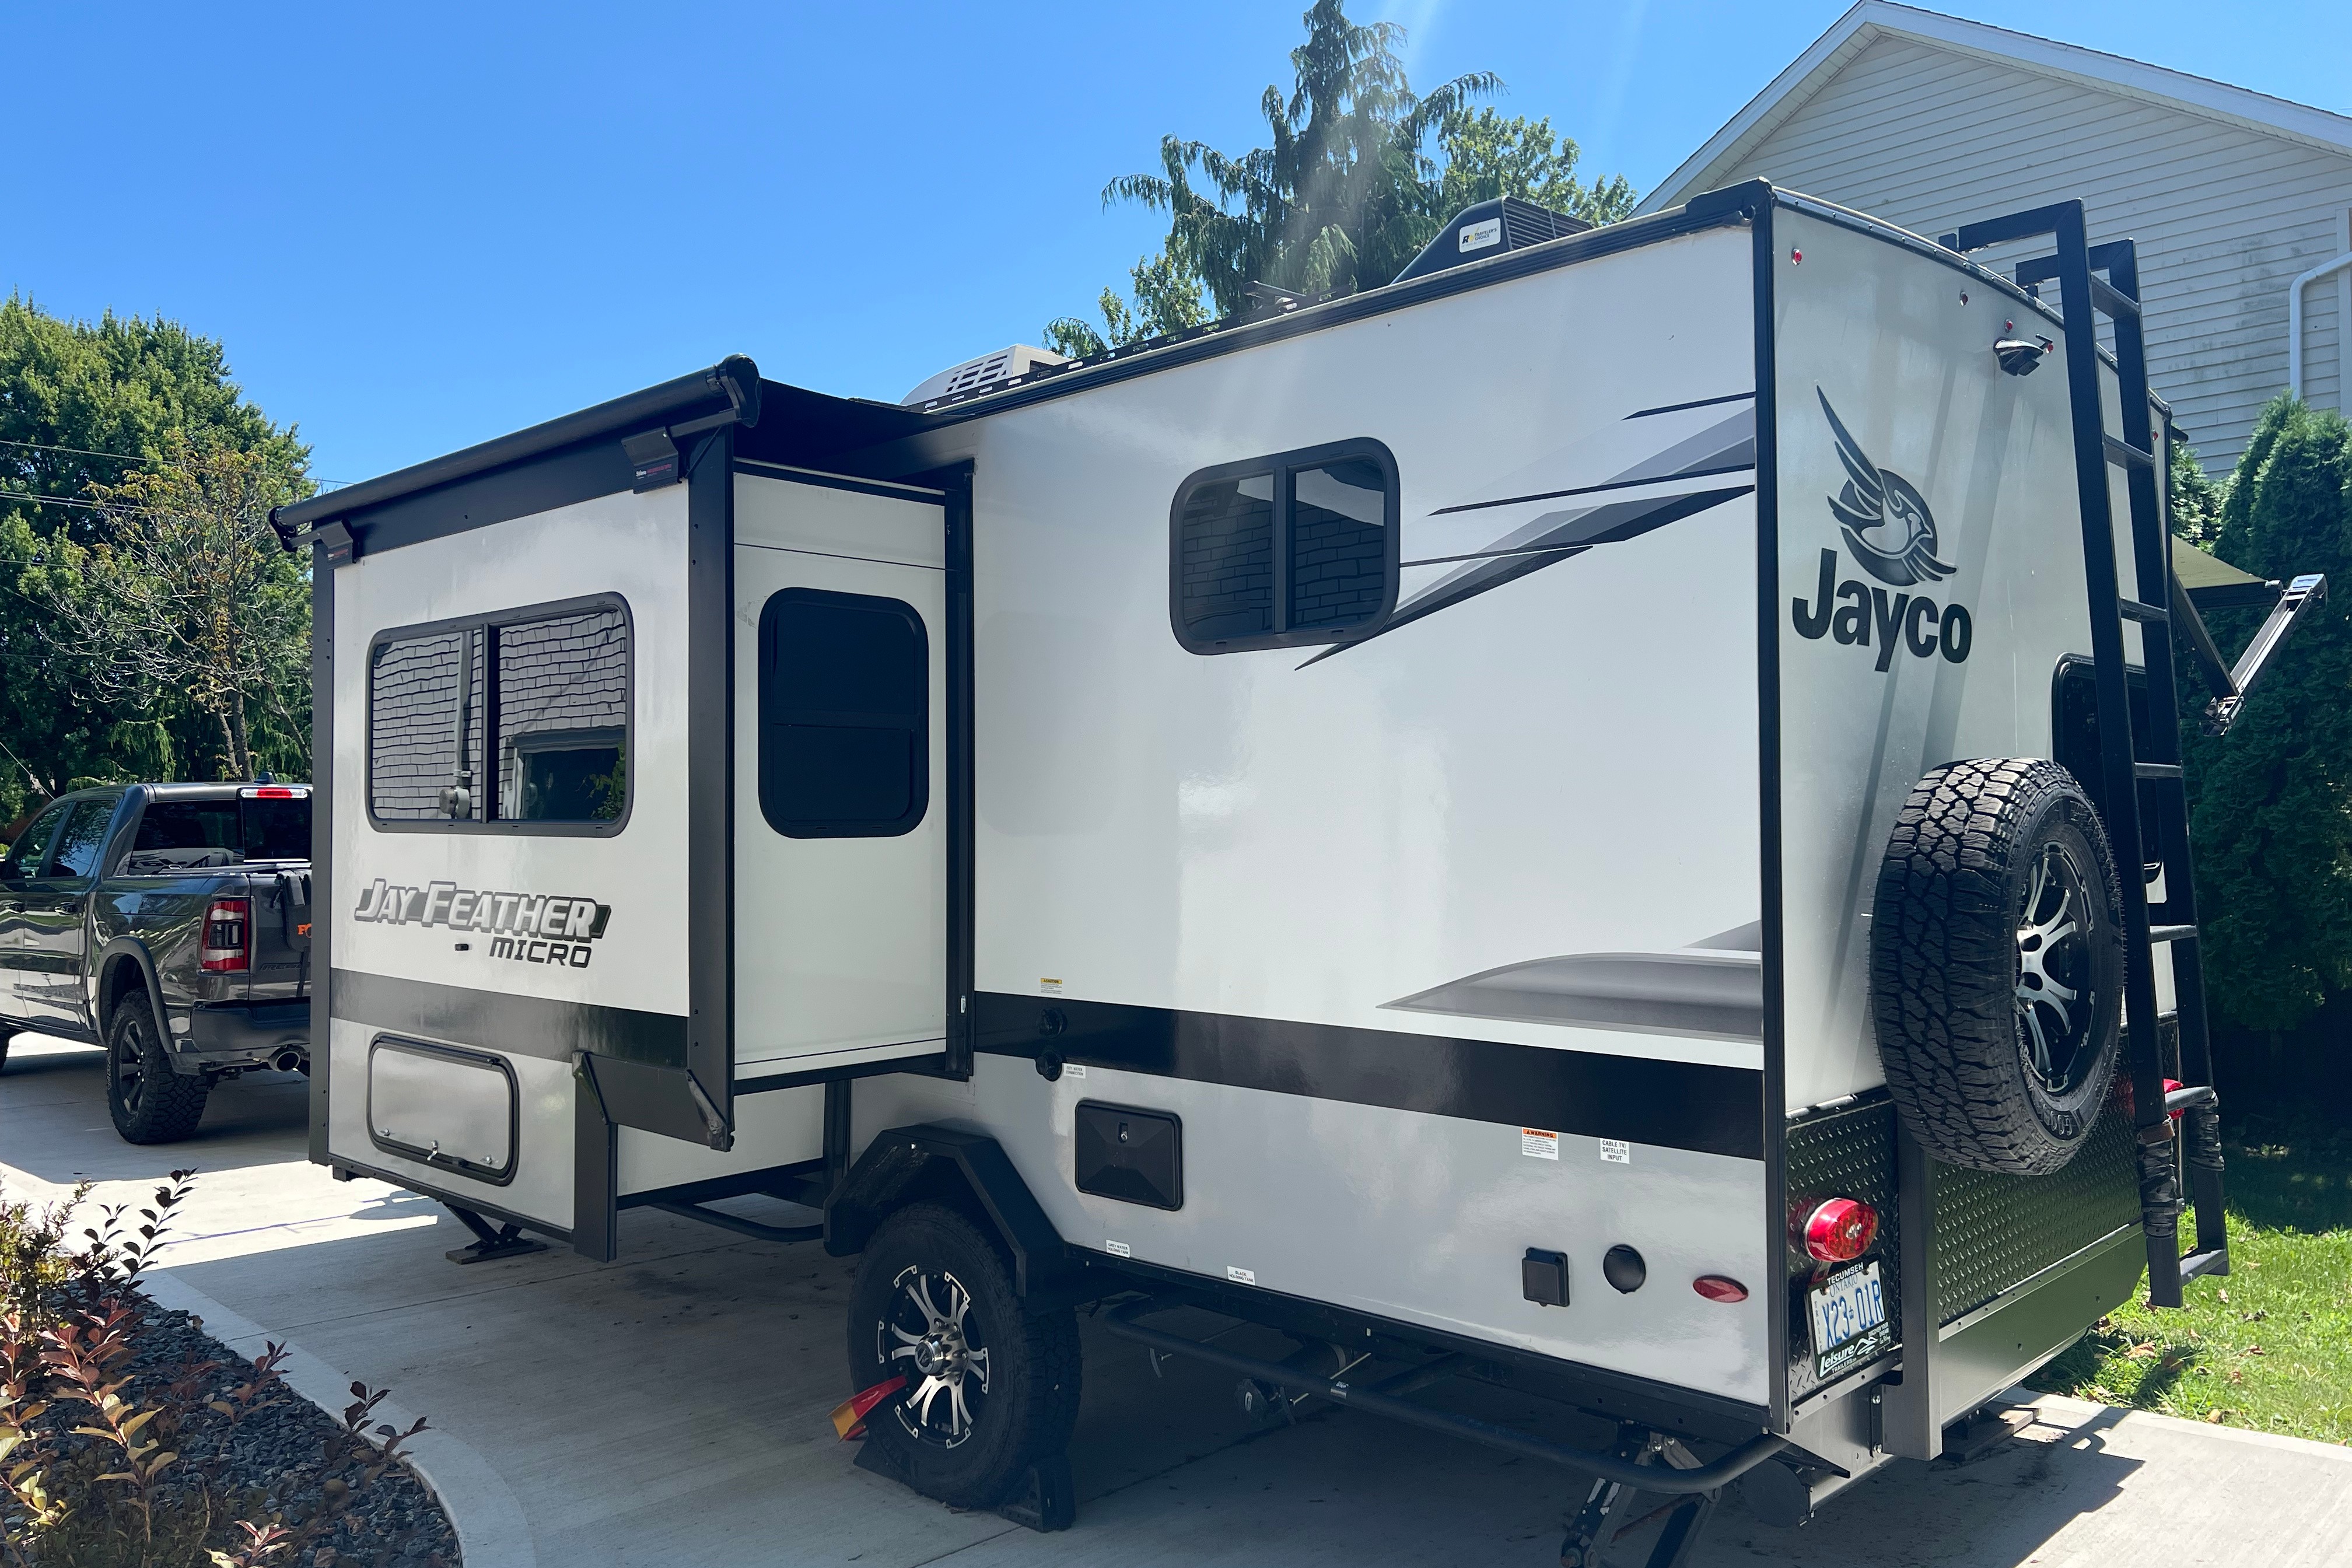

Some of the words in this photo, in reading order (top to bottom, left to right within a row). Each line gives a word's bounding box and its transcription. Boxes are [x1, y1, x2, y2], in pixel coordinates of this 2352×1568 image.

[1792, 547, 1972, 673] Jayco
[354, 878, 419, 925] JAY
[421, 880, 597, 943] FEATHER
[298, 923, 312, 938] FO
[489, 936, 592, 968] MICRO
[1602, 1147, 1627, 1155] SATELLITE
[1827, 1262, 1864, 1285] TECUMSEH
[1829, 1275, 1858, 1297] ONTARIO
[1814, 1300, 1822, 1352] TRAILE
[1820, 1345, 1855, 1377] Leisure
